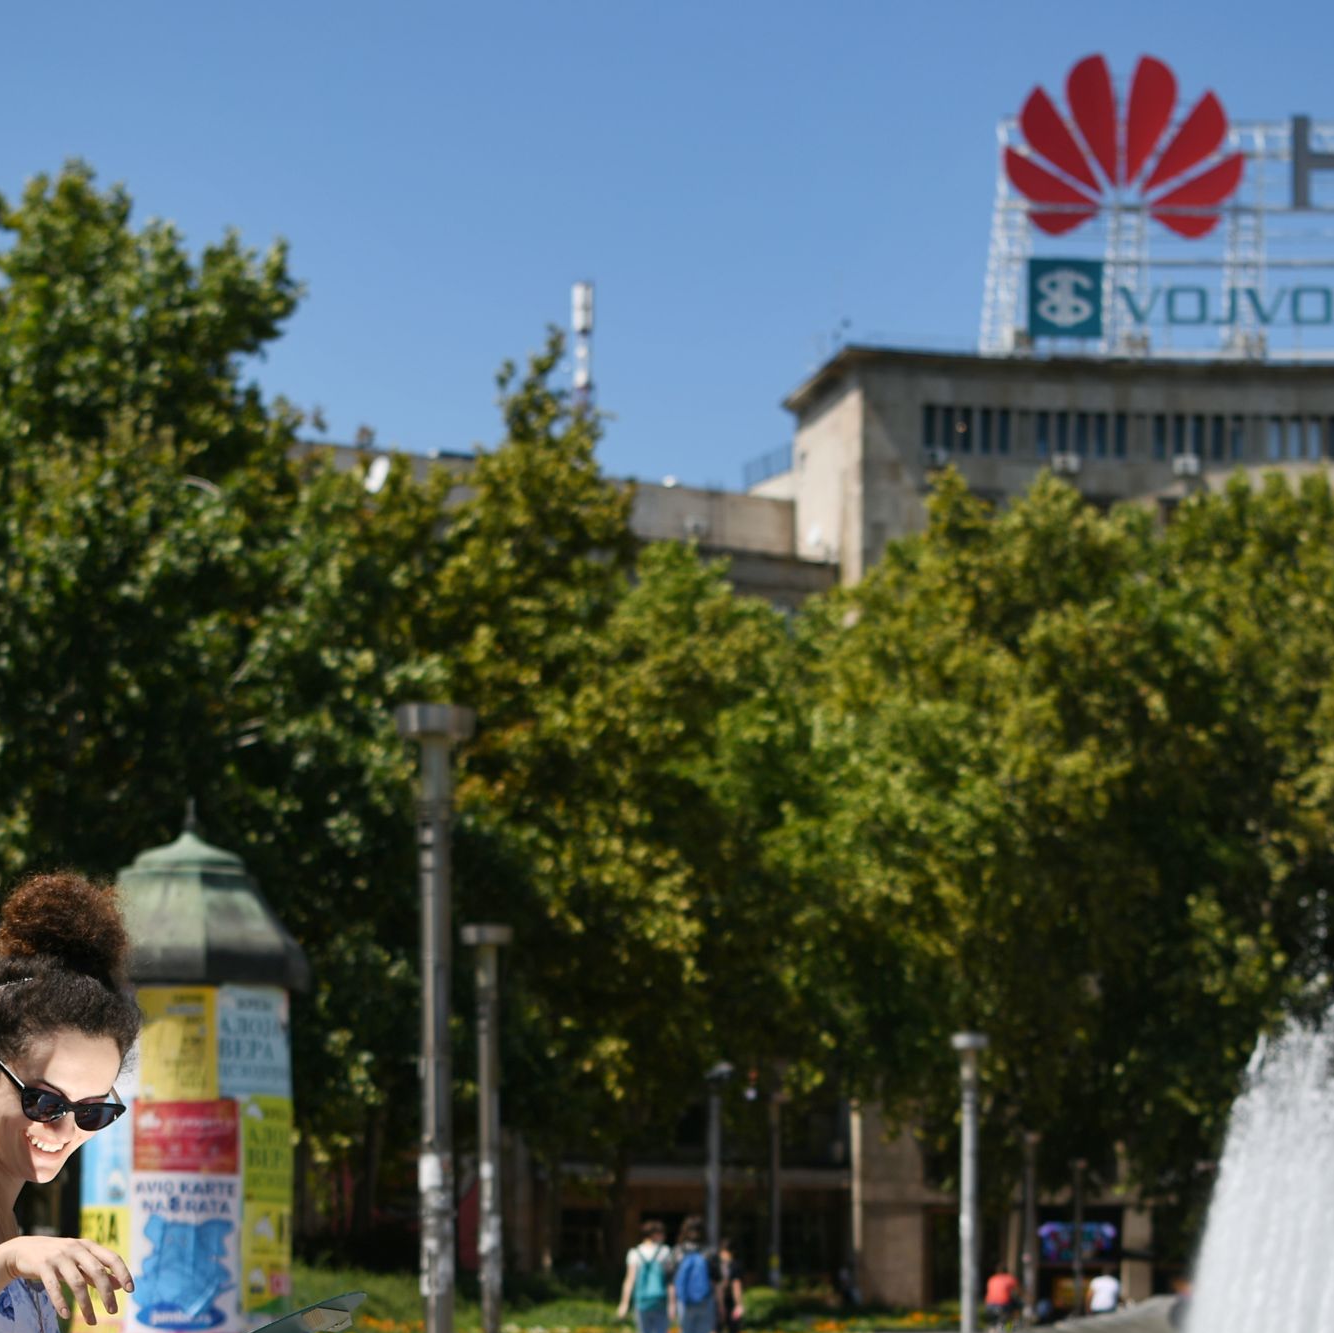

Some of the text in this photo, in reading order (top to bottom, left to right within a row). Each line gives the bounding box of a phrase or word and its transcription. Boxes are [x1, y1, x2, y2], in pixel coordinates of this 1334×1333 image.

[135, 1181, 237, 1198] AVIO KARTE
[142, 1200, 165, 1213] NA
[184, 1200, 232, 1214] RATA
